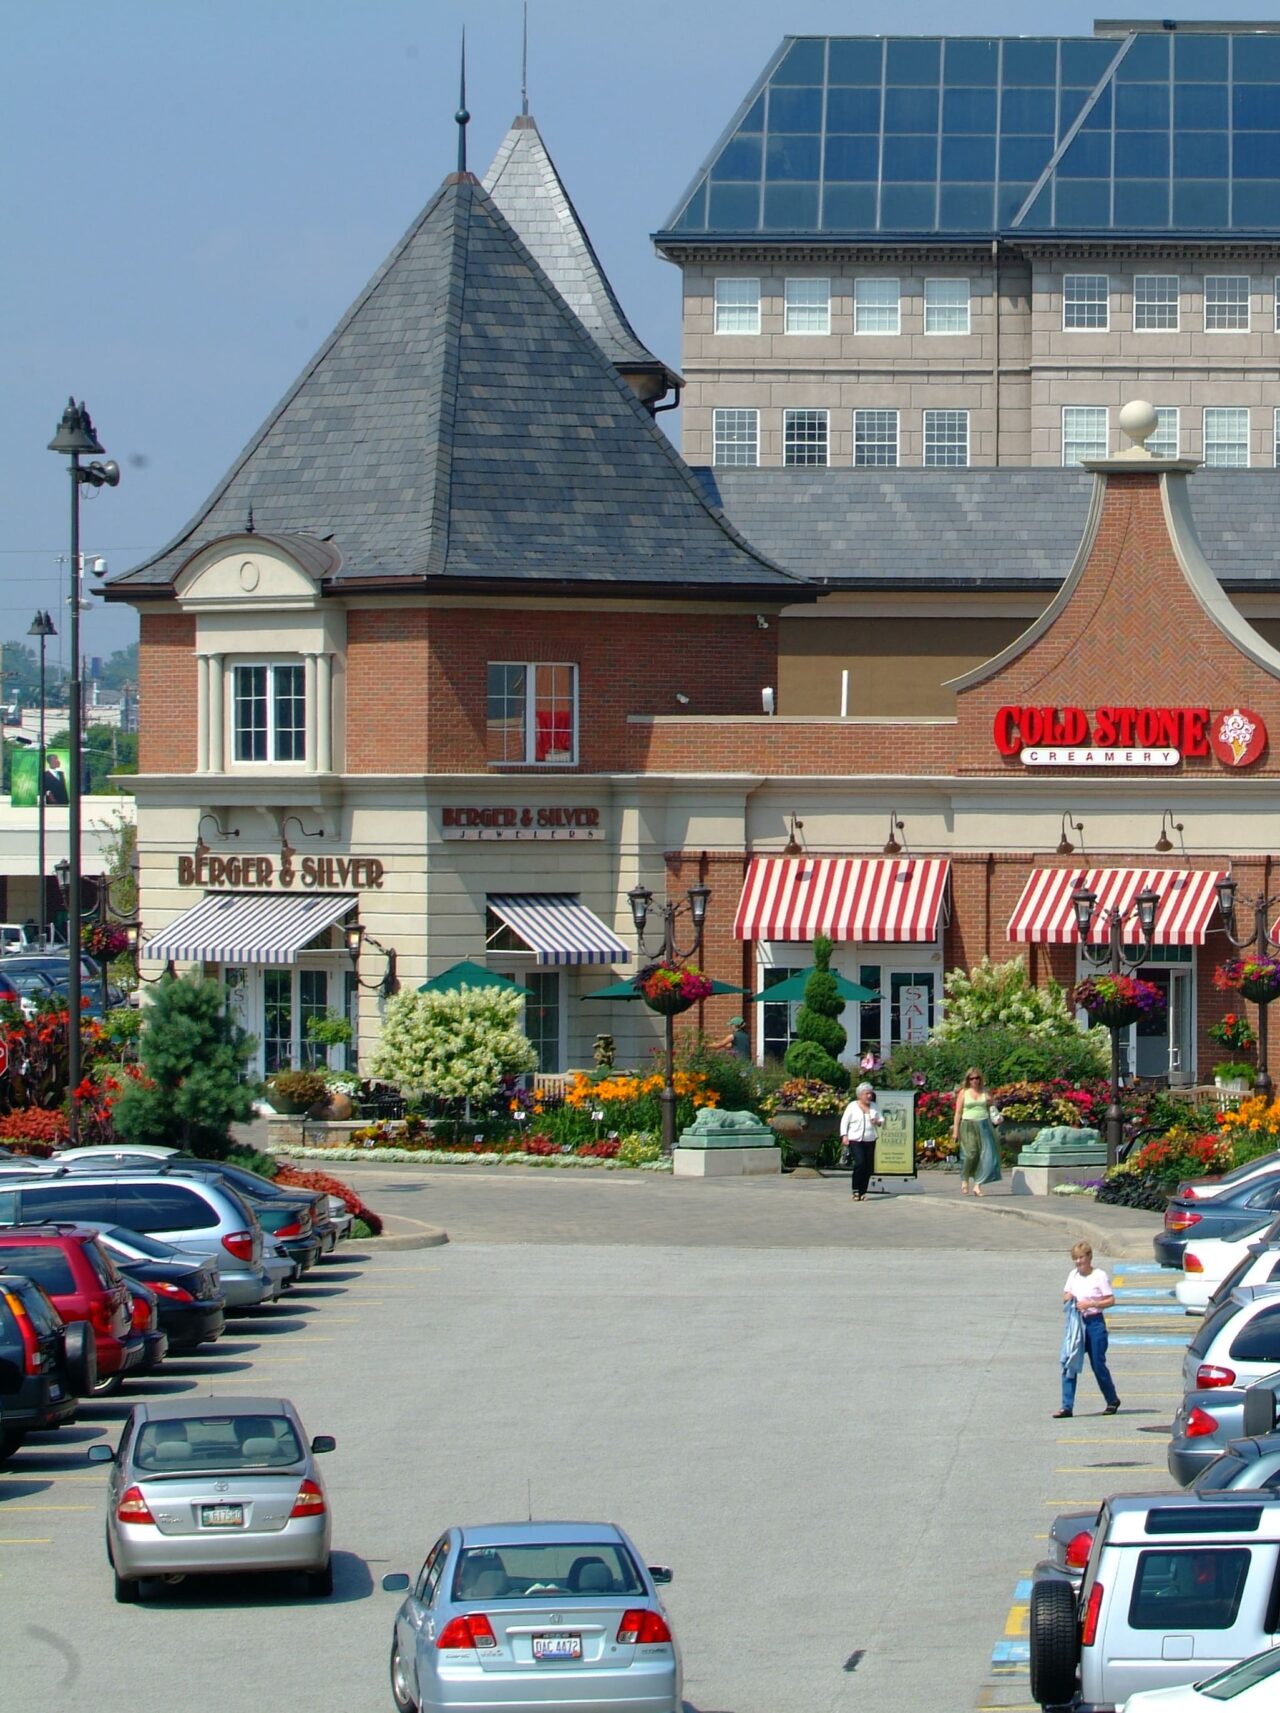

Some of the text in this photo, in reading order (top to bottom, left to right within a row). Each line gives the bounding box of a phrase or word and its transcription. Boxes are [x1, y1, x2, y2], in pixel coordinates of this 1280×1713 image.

[993, 705, 1210, 757] COLD STONE
[1030, 751, 1170, 762] CREAMERY
[442, 807, 600, 828] BERGER & SILVER
[459, 830, 594, 839] JEWELERS
[178, 855, 384, 889] BERGER & SILVER
